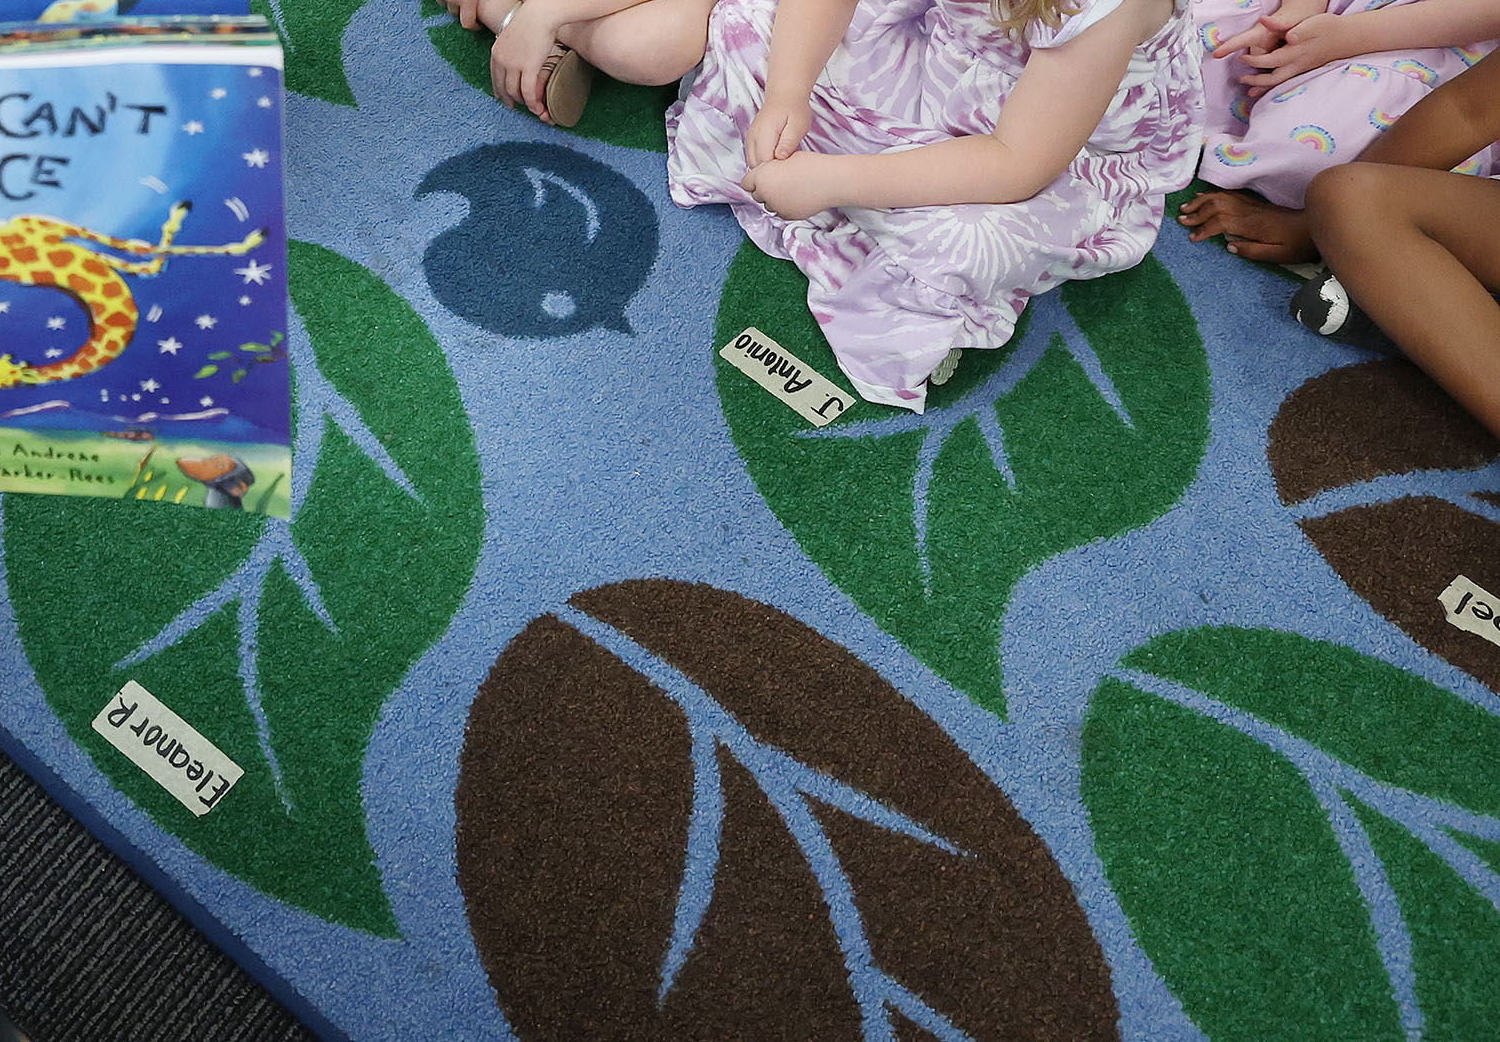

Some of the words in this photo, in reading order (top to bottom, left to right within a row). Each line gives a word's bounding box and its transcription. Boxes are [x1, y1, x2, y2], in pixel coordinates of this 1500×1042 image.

[734, 334, 813, 393] Antonio
[810, 393, 844, 420] J.
[108, 692, 138, 728] R
[130, 717, 230, 808] Eleanor
